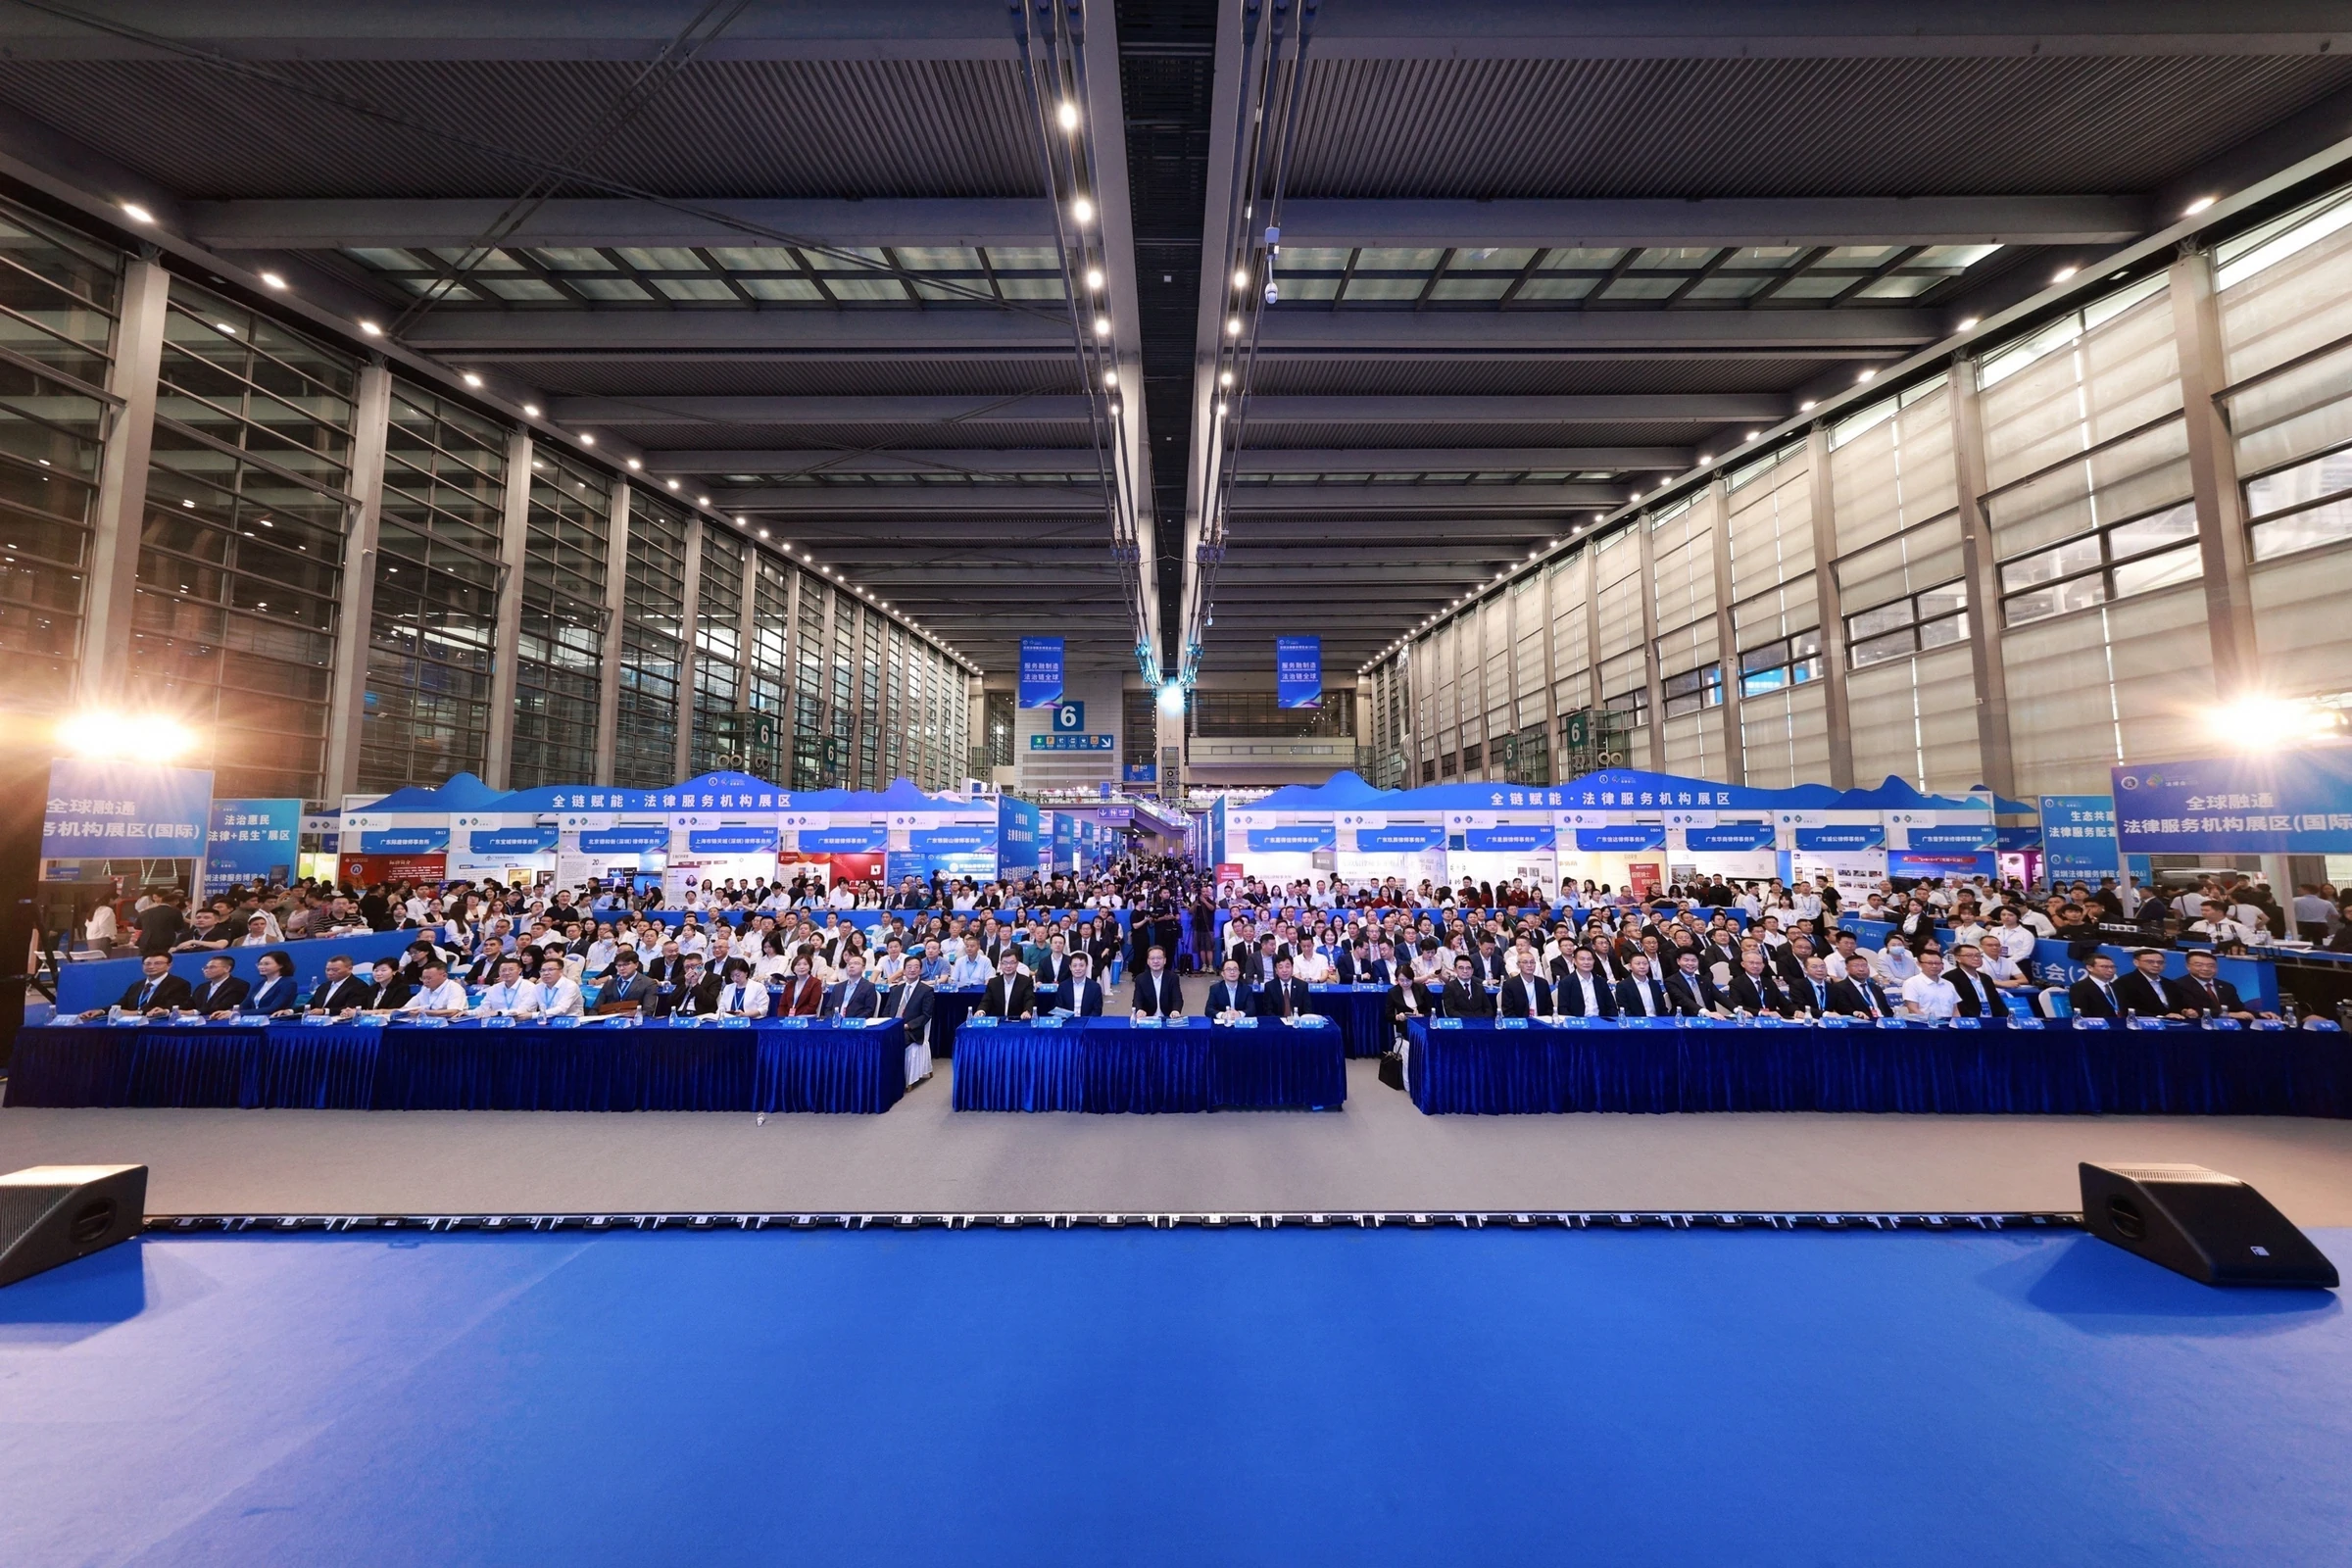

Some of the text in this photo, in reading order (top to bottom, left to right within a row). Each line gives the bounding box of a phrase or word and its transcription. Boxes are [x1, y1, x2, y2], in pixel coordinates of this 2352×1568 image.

[1060, 705, 1077, 727] 6
[760, 724, 769, 744] 6
[1571, 722, 1580, 743] 6
[827, 745, 834, 761] 6
[1506, 744, 1513, 760] 6
[45, 798, 136, 816] 全球融通
[2185, 792, 2275, 811] 全球融通
[224, 814, 270, 826] 法治惠民
